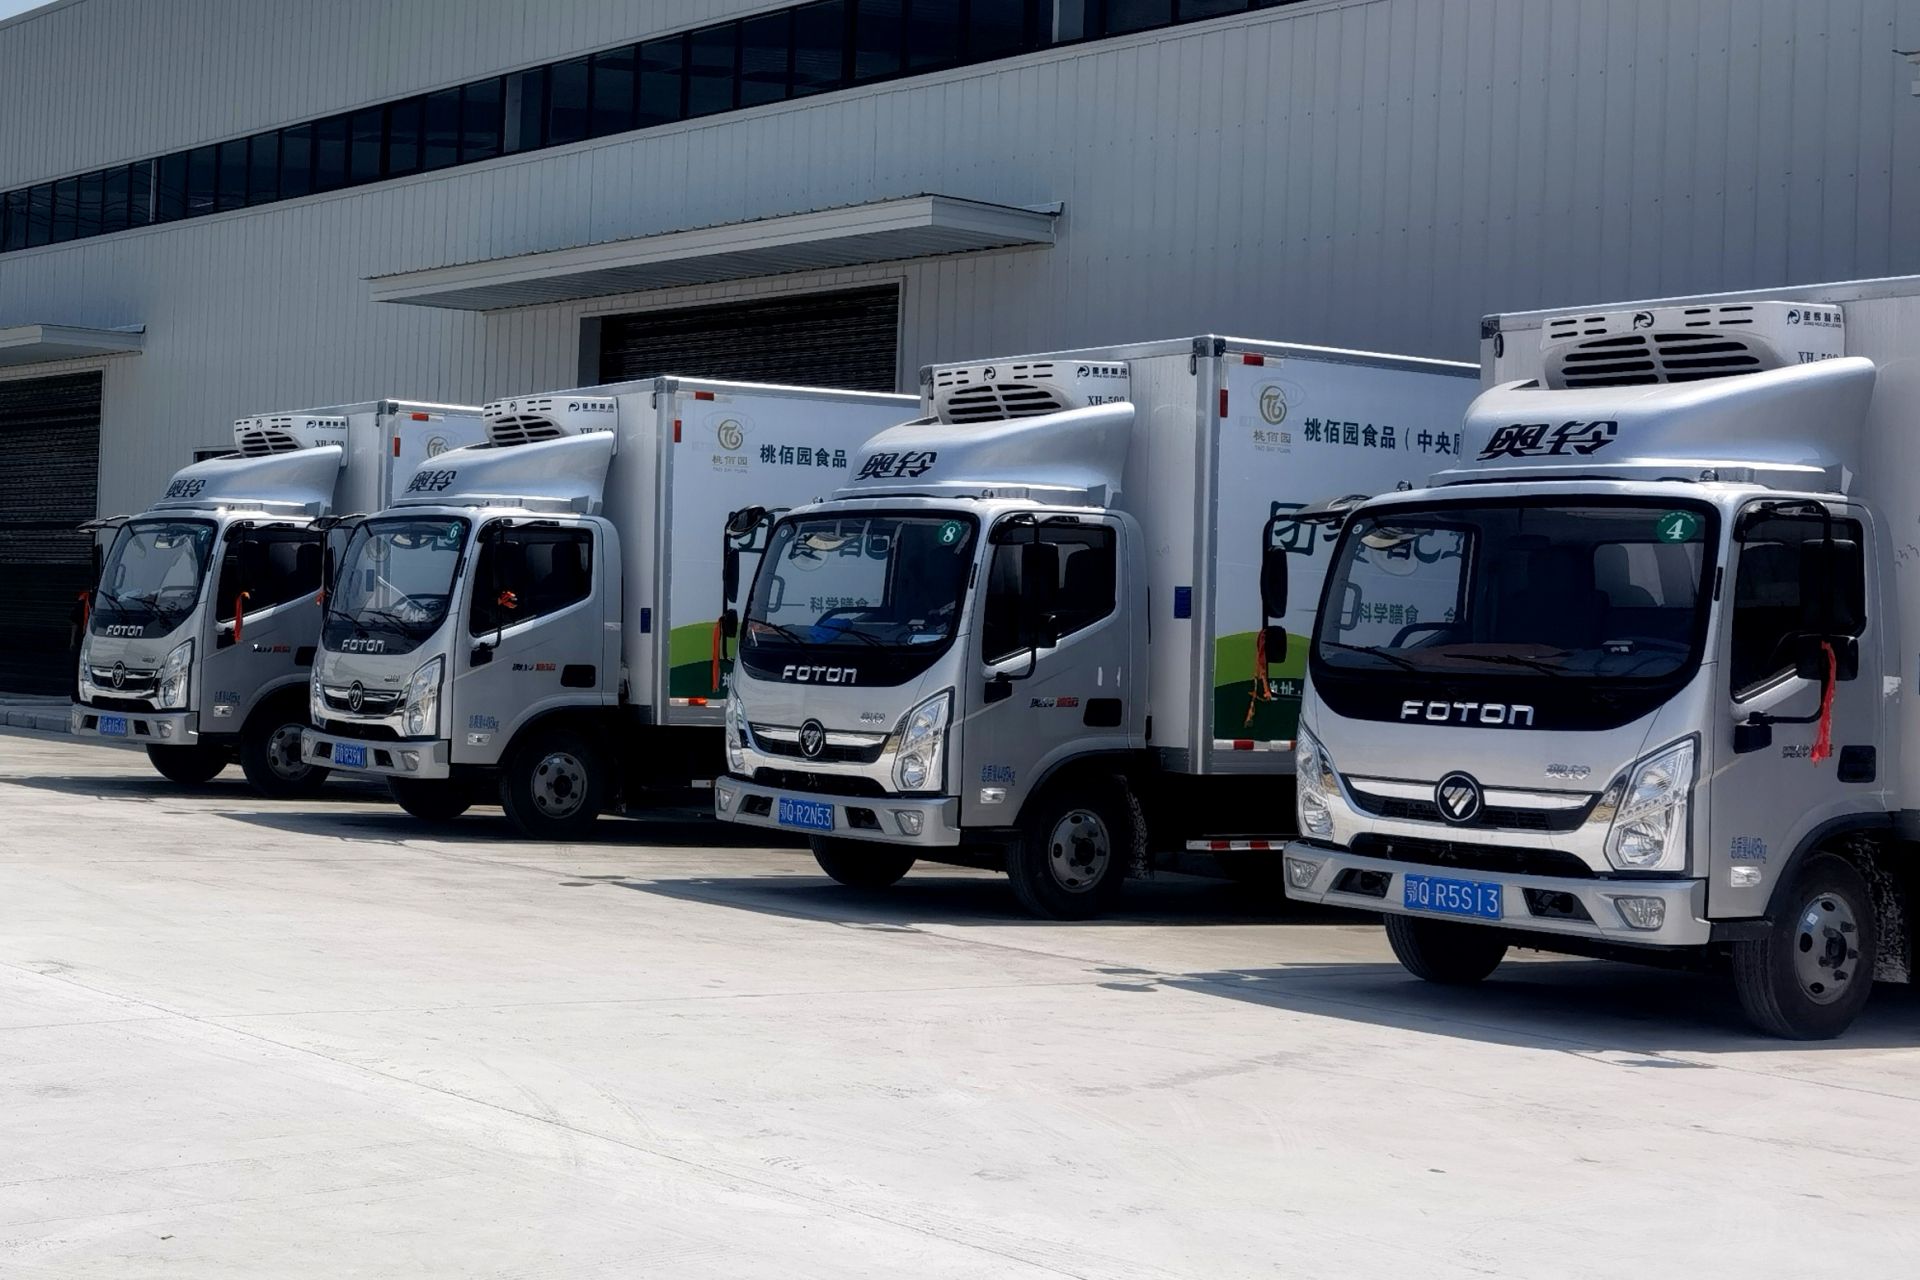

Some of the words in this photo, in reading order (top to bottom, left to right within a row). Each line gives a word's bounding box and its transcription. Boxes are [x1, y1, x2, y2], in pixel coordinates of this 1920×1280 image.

[1476, 421, 1617, 461] 奥铃
[760, 444, 847, 468] 桃佰园食品
[855, 451, 937, 481] 奥铃
[449, 526, 459, 539] 6
[943, 526, 956, 542] 8
[1666, 519, 1684, 539] 4
[105, 624, 144, 637] FOTON
[341, 639, 385, 653] FOTON
[782, 664, 857, 684] FOTON
[1400, 700, 1534, 726] FOTON
